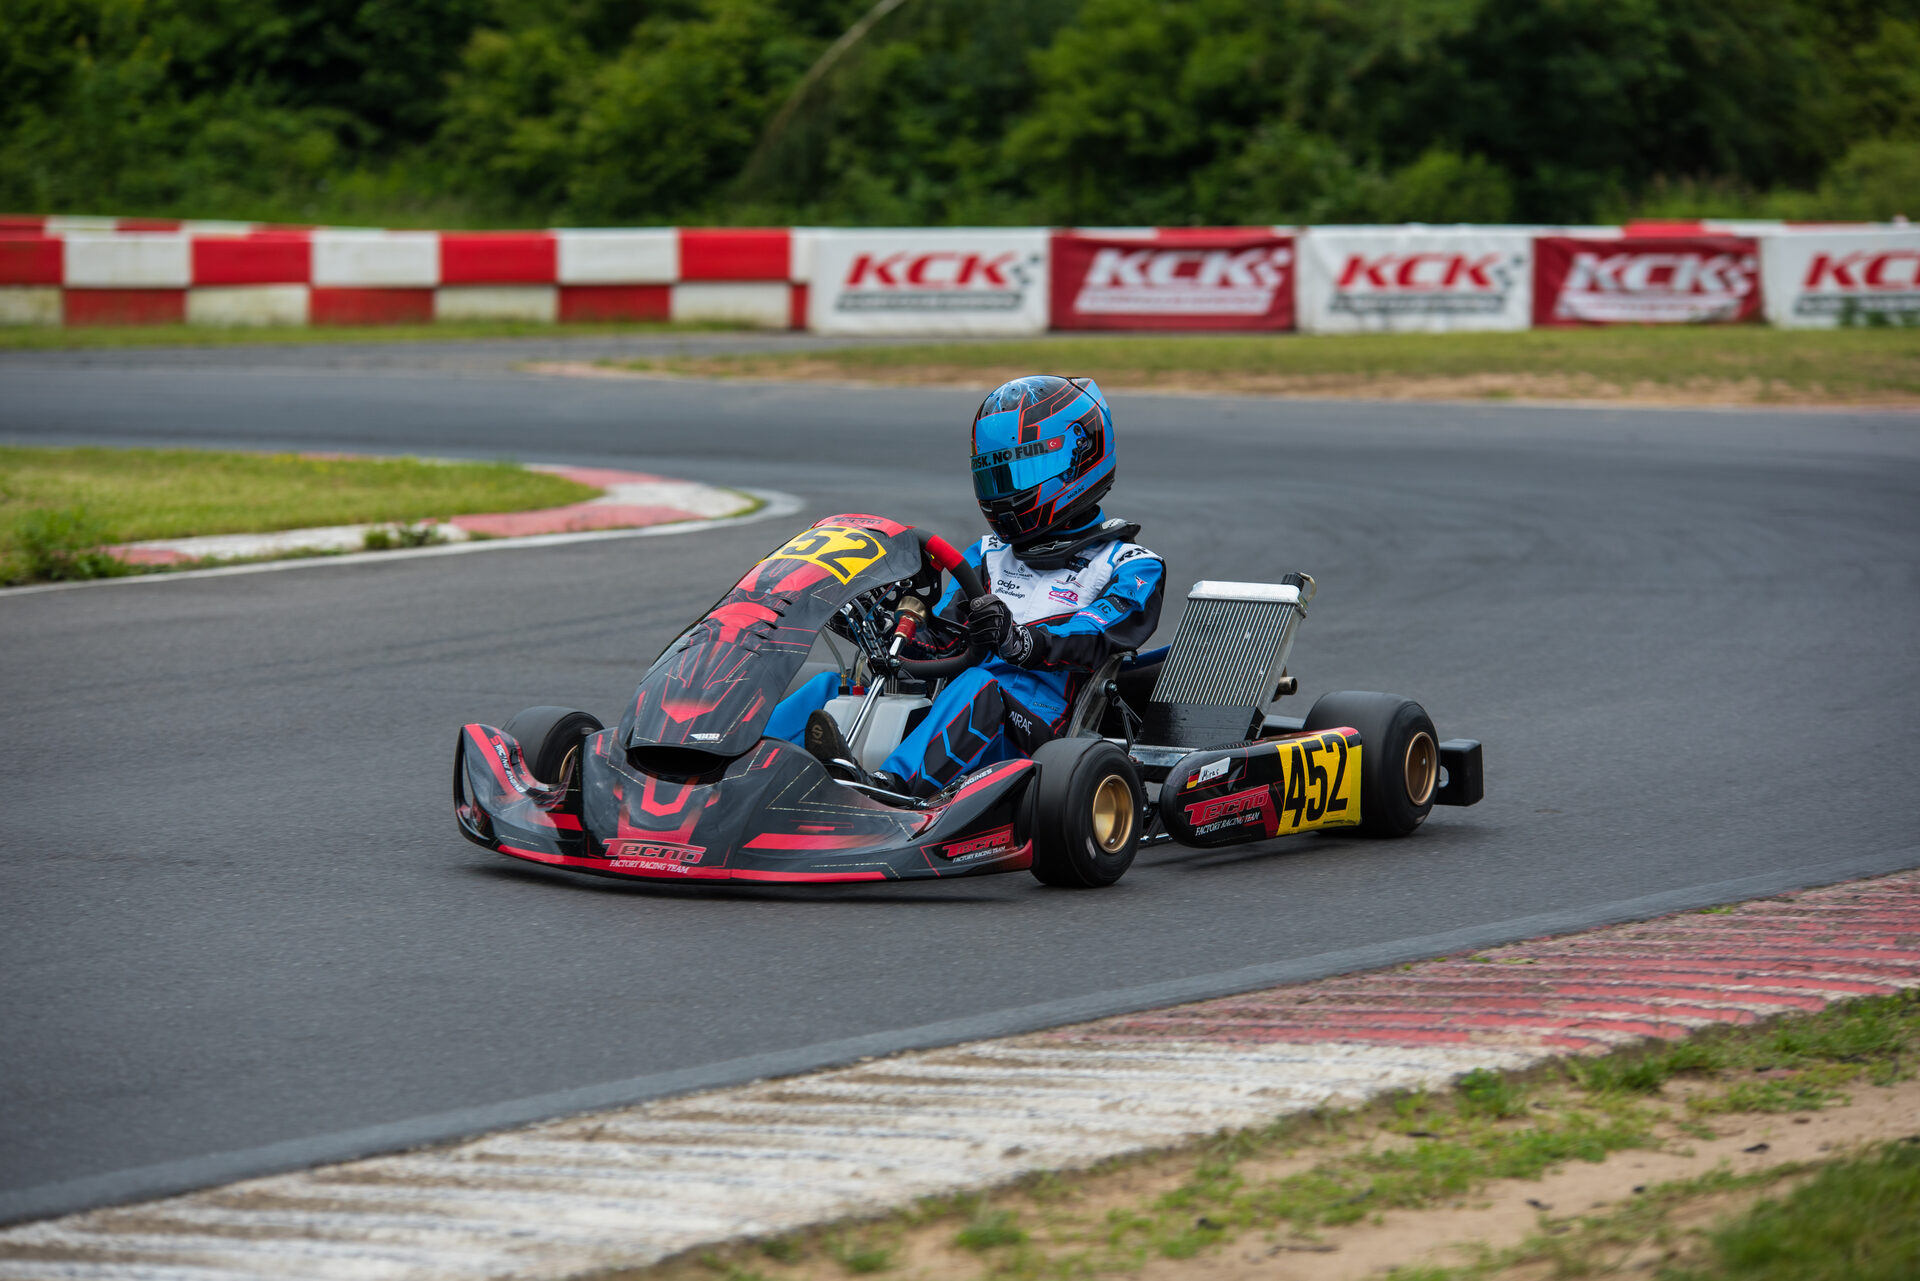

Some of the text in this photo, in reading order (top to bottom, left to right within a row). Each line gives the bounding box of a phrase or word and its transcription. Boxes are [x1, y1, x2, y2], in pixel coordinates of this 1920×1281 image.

[844, 252, 1016, 289] KCK
[1087, 249, 1263, 286] KCK
[1338, 254, 1502, 290] KCK
[1567, 253, 1731, 291] KCK
[1803, 250, 1919, 290] KC
[768, 527, 879, 579] 52
[1284, 733, 1348, 828] 452
[1184, 784, 1269, 825] Tecno
[1195, 811, 1260, 836] FACTORY RACING TEAM
[602, 838, 707, 864] Tecno
[943, 830, 1010, 857] Tecno
[953, 855, 974, 863] FACTORY
[975, 850, 992, 858] RACING
[609, 859, 690, 874] FACTORY RACING TEAM
